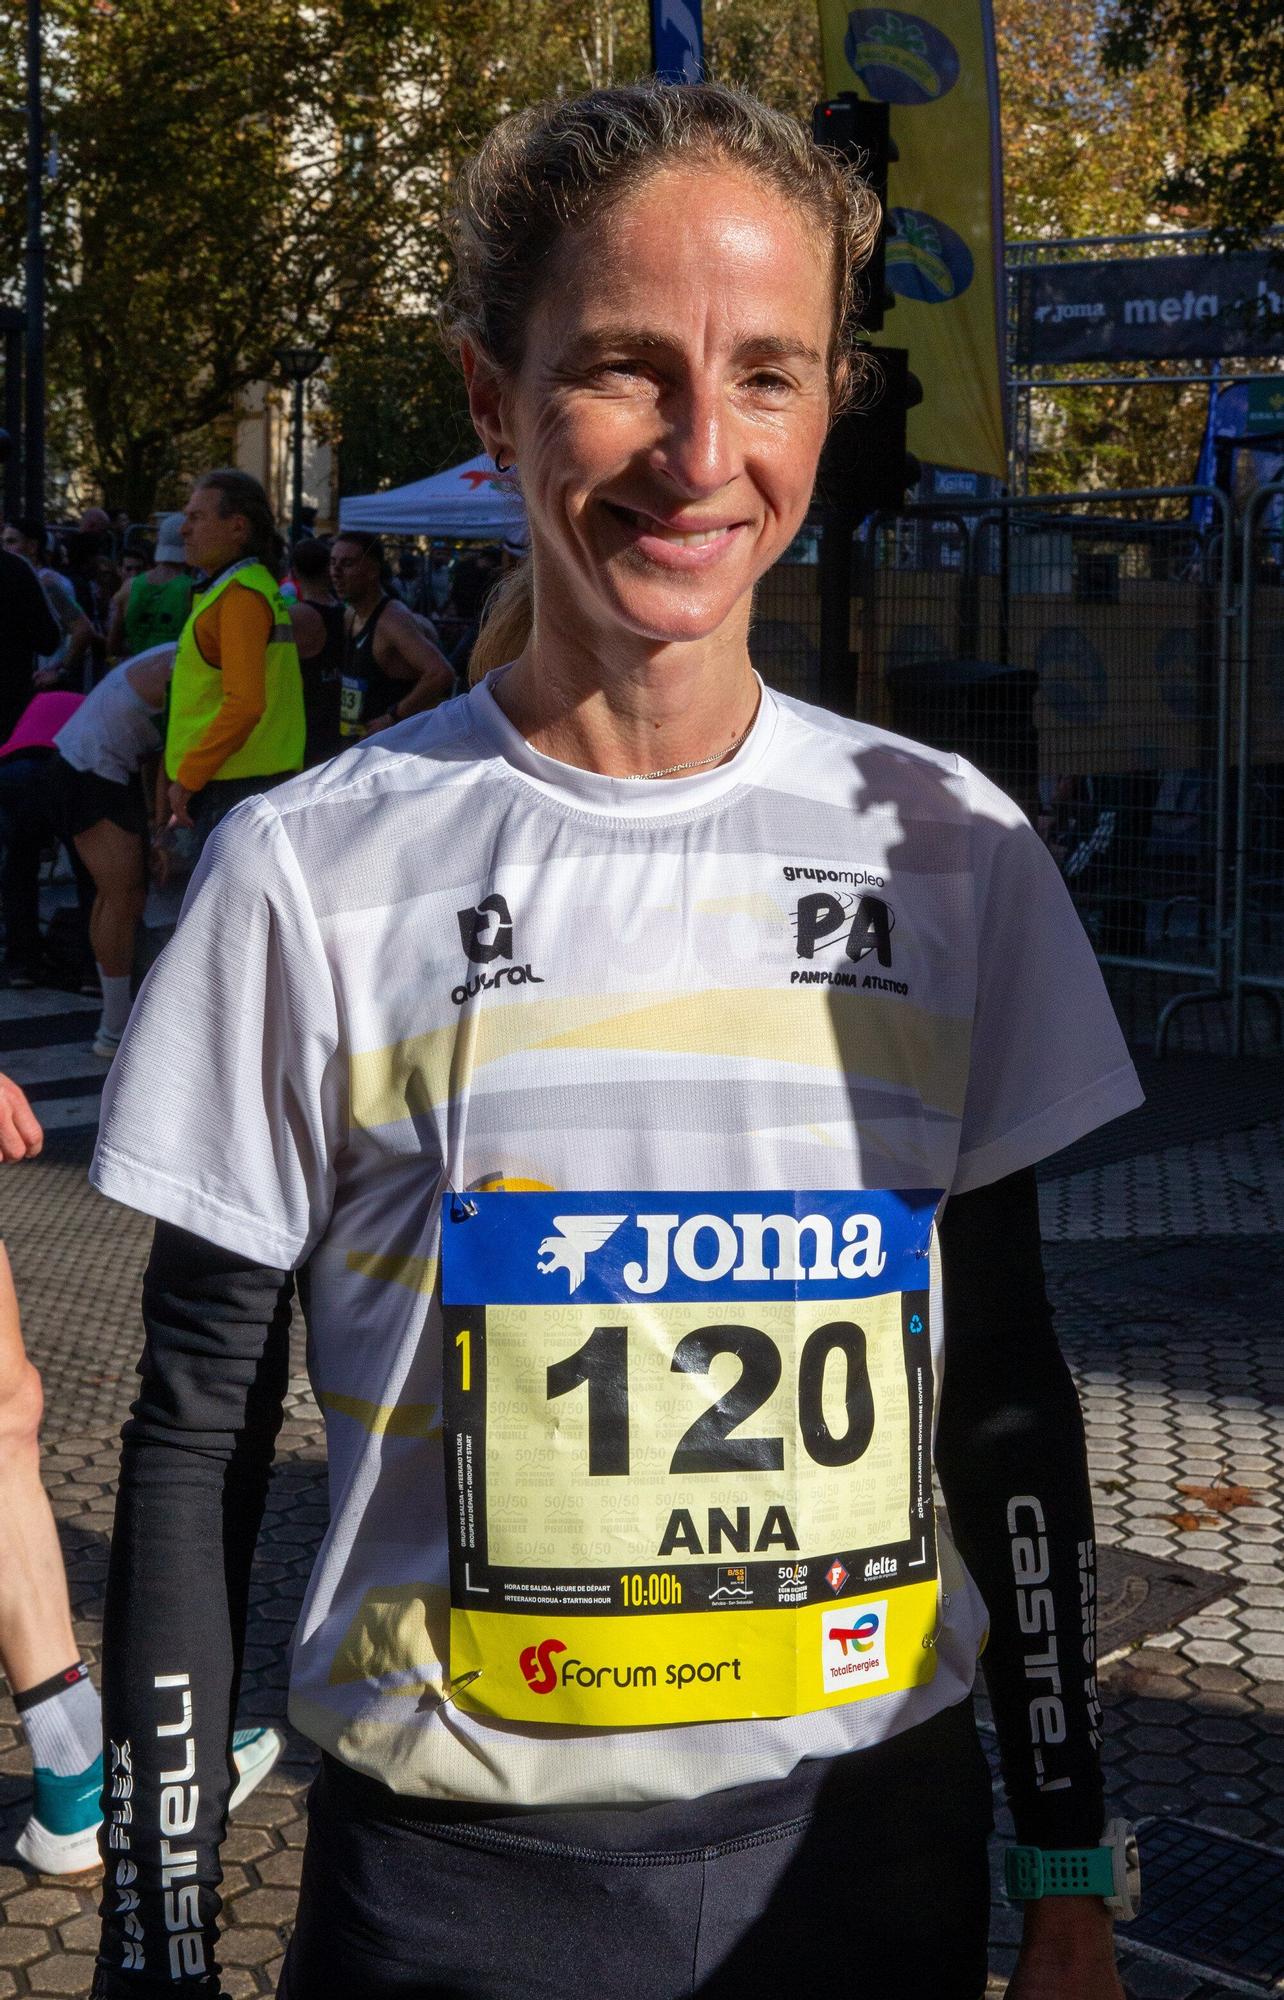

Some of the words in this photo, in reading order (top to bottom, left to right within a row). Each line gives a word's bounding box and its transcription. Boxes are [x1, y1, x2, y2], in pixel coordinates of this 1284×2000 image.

[1123, 289, 1220, 325] meta
[783, 864, 885, 888] grupompleo
[790, 970, 857, 988] PAMPLONA
[862, 972, 908, 996] ATLETICO
[455, 1330, 472, 1392] 1
[546, 1320, 875, 1477] 120
[466, 1455, 472, 1464] AT
[459, 1516, 466, 1526] DE
[468, 1513, 474, 1523] AU
[656, 1504, 801, 1557] ANA
[778, 1563, 808, 1581] 50/50
[864, 1556, 897, 1577] delta
[504, 1583, 521, 1591] HORA
[586, 1583, 611, 1592] DÉPART
[620, 1573, 682, 1607] 10:00h
[778, 1590, 808, 1603] POSIBLE
[537, 1596, 559, 1604] ORDUA
[665, 1658, 741, 1690] sport
[830, 1658, 880, 1679] TotalEnergies
[109, 1737, 134, 1850] FLEX
